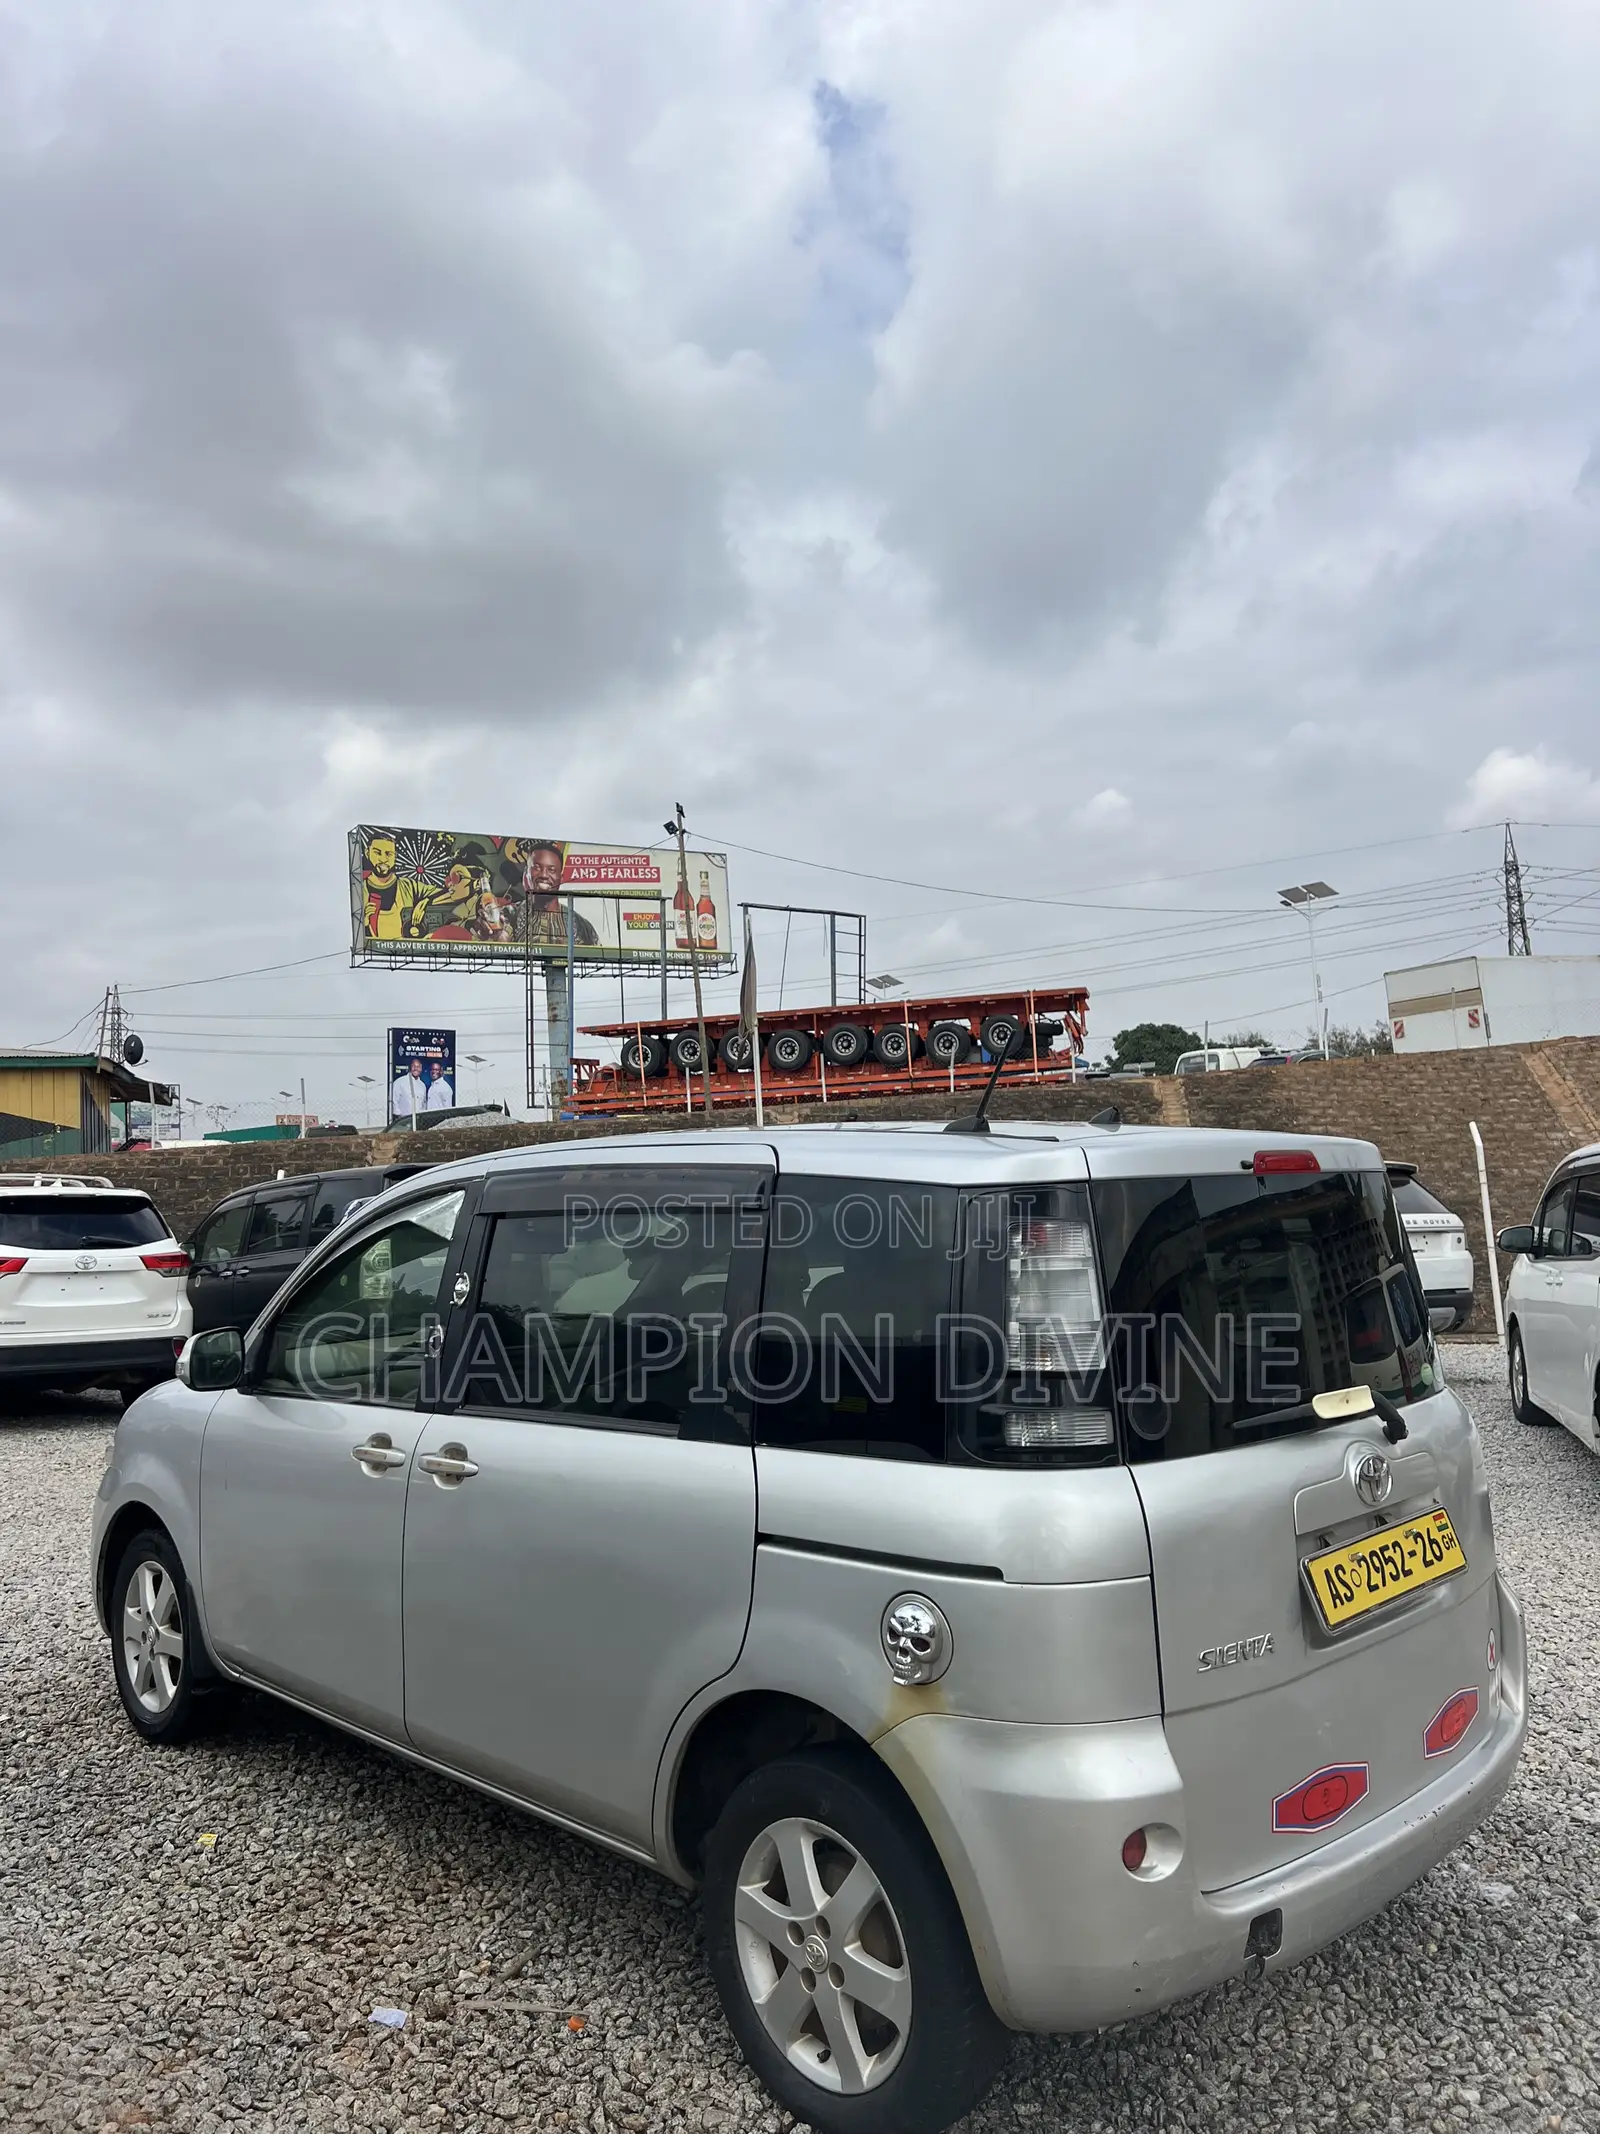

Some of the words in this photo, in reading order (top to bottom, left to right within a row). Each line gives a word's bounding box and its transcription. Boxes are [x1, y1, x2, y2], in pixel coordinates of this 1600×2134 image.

[570, 857, 581, 865] TO
[583, 857, 599, 865] THE
[601, 857, 647, 865] AUTHENTIC
[571, 868, 598, 879] AND
[601, 868, 658, 879] FEARLESS
[628, 921, 649, 929] YOUR
[649, 921, 674, 929] ORIN
[376, 941, 394, 949] THIS
[396, 942, 426, 950] ADVERT
[633, 950, 654, 958] DRINK
[1441, 1531, 1457, 1551] GH
[1324, 1563, 1354, 1609] AS
[1358, 1528, 1444, 1593] 2952-26
[1197, 1632, 1275, 1674] SIENTA
